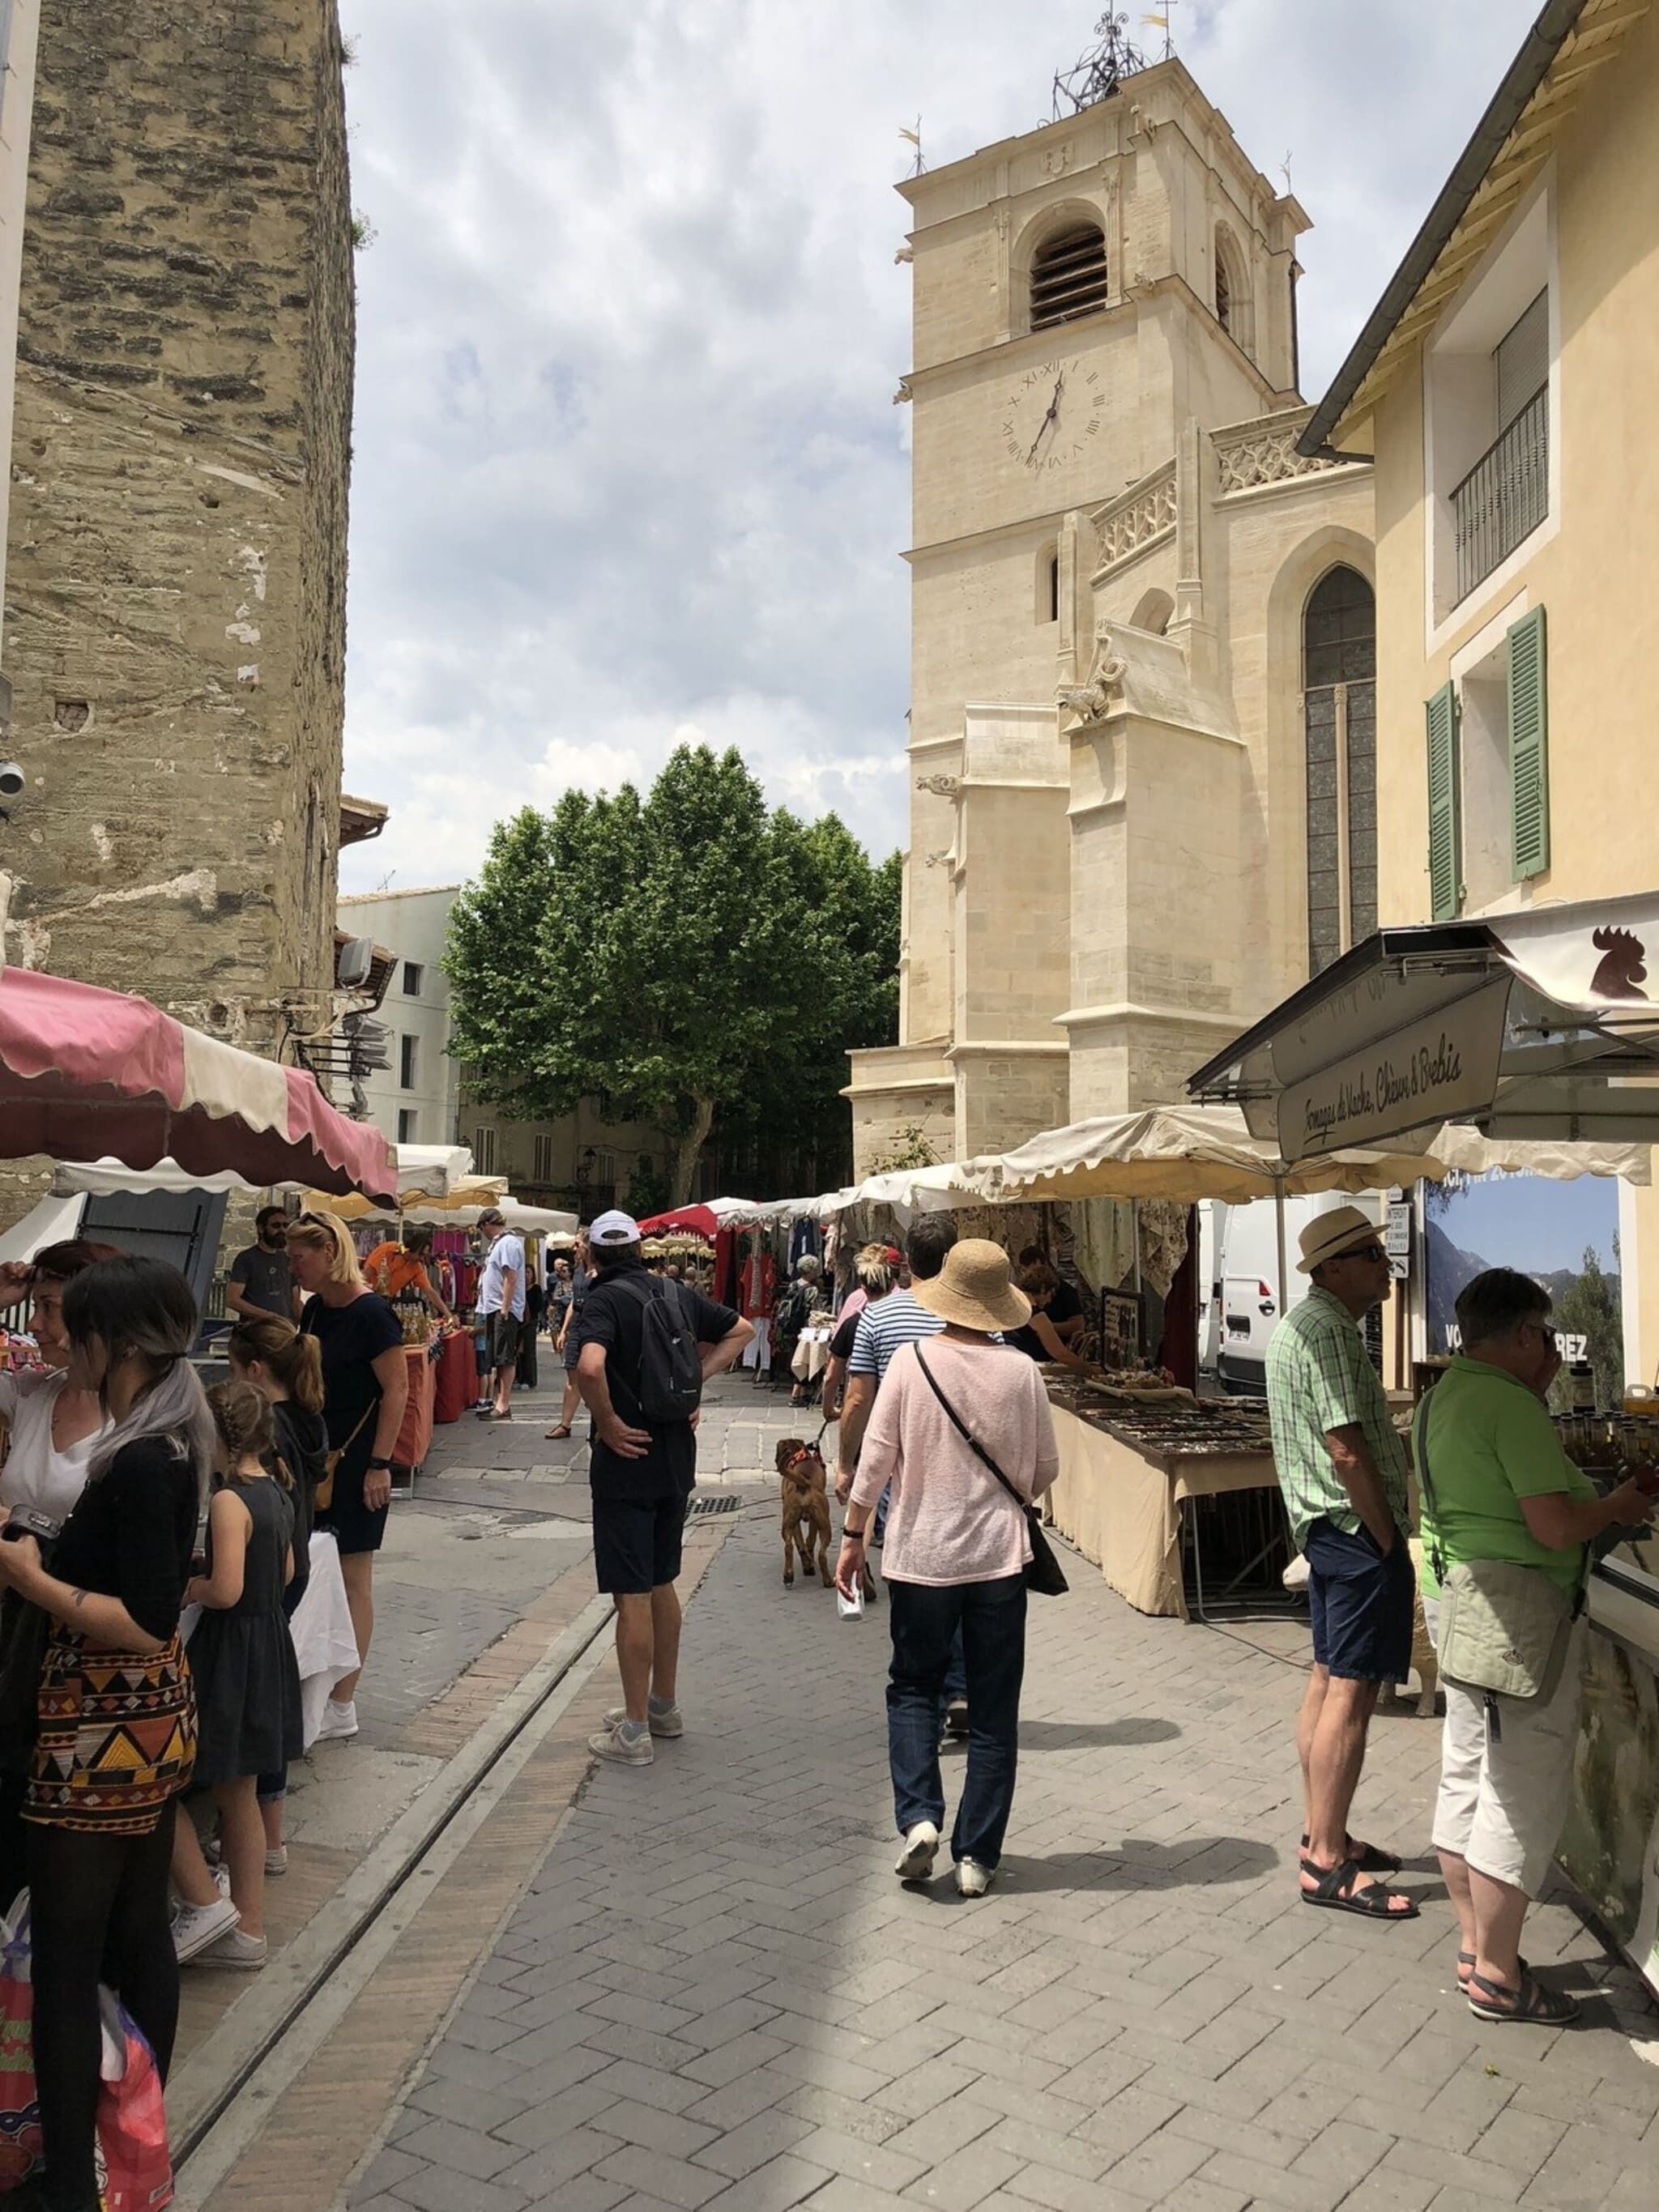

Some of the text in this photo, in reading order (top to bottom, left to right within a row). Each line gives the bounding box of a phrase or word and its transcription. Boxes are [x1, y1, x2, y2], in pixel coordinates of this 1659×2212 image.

[1043, 359, 1060, 377] XII
[1022, 371, 1037, 389] XI
[1085, 371, 1098, 385] II
[1007, 396, 1021, 407] X
[1093, 394, 1106, 407] III
[1073, 444, 1084, 457] V
[1337, 1082, 1346, 1122] de
[1419, 1032, 1462, 1093] Brebis
